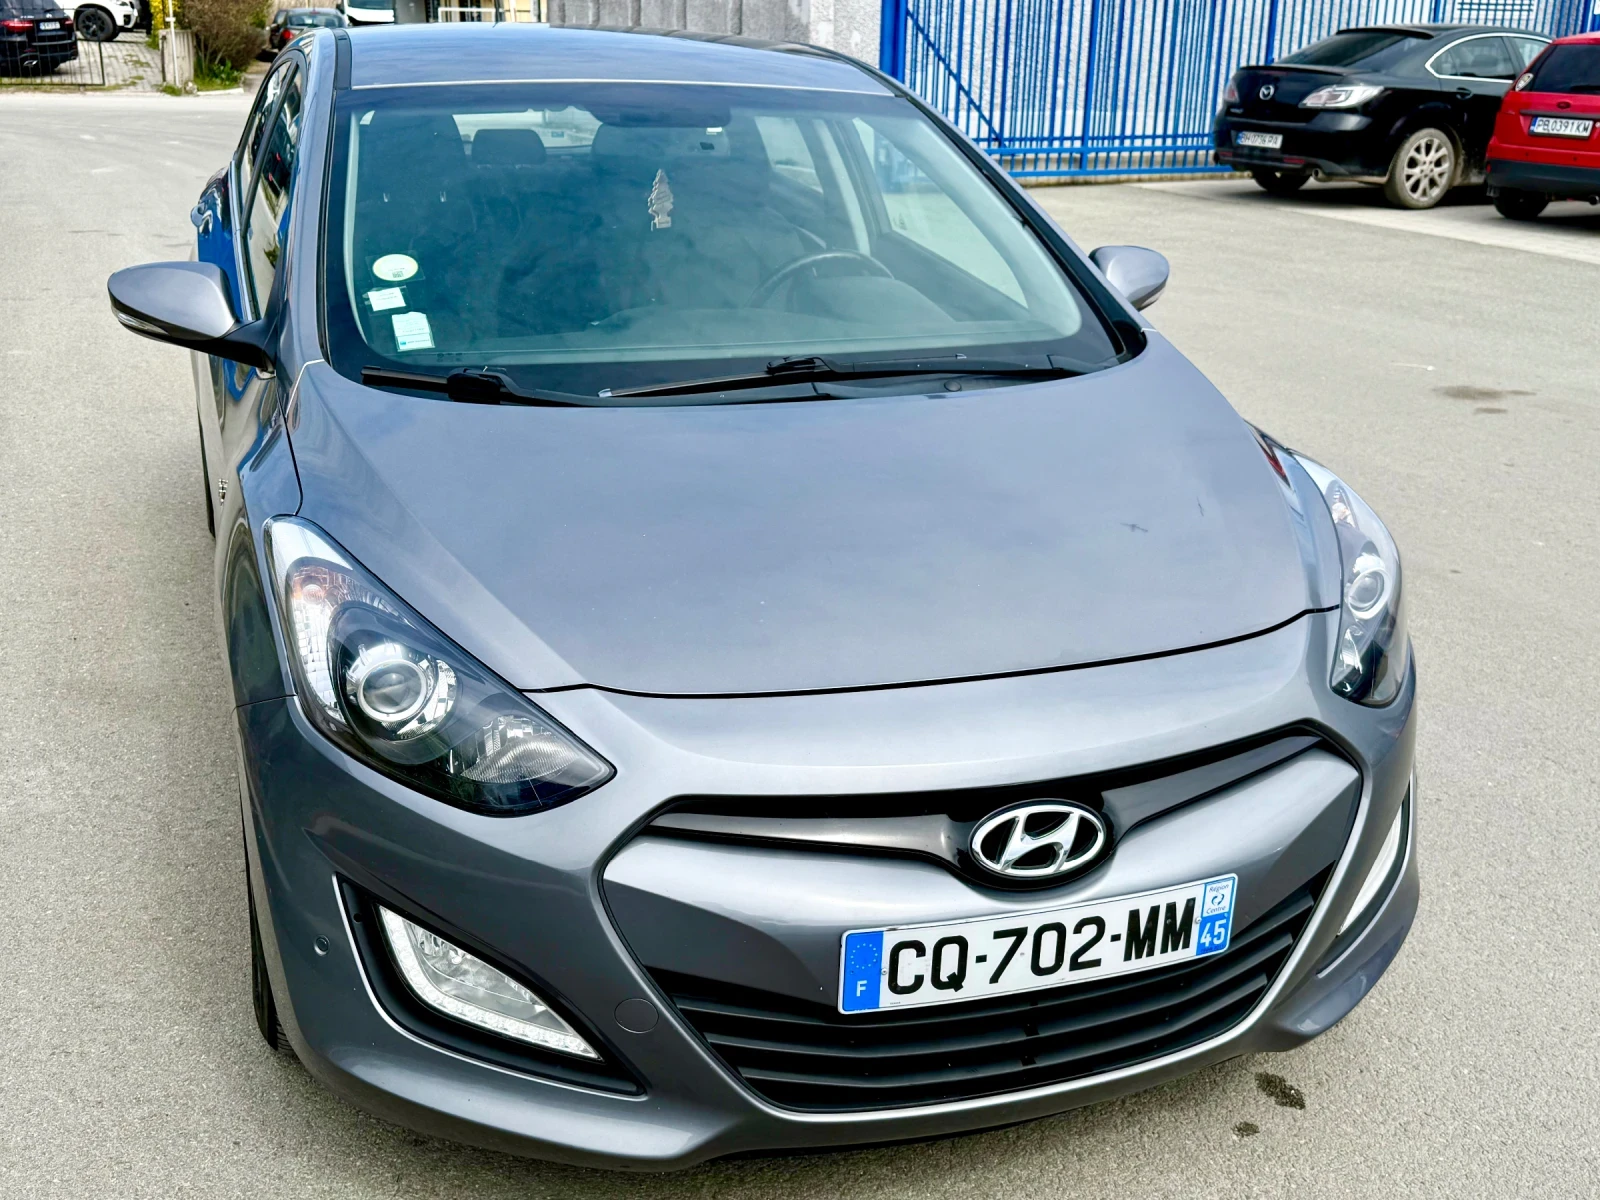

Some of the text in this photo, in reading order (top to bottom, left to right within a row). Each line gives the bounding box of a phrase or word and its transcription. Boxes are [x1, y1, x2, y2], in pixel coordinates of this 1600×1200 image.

[1209, 884, 1229, 893] Région
[1206, 905, 1226, 914] Centre
[1200, 919, 1226, 946] 45
[888, 897, 1197, 995] CQ-702-MM
[856, 980, 868, 997] F
